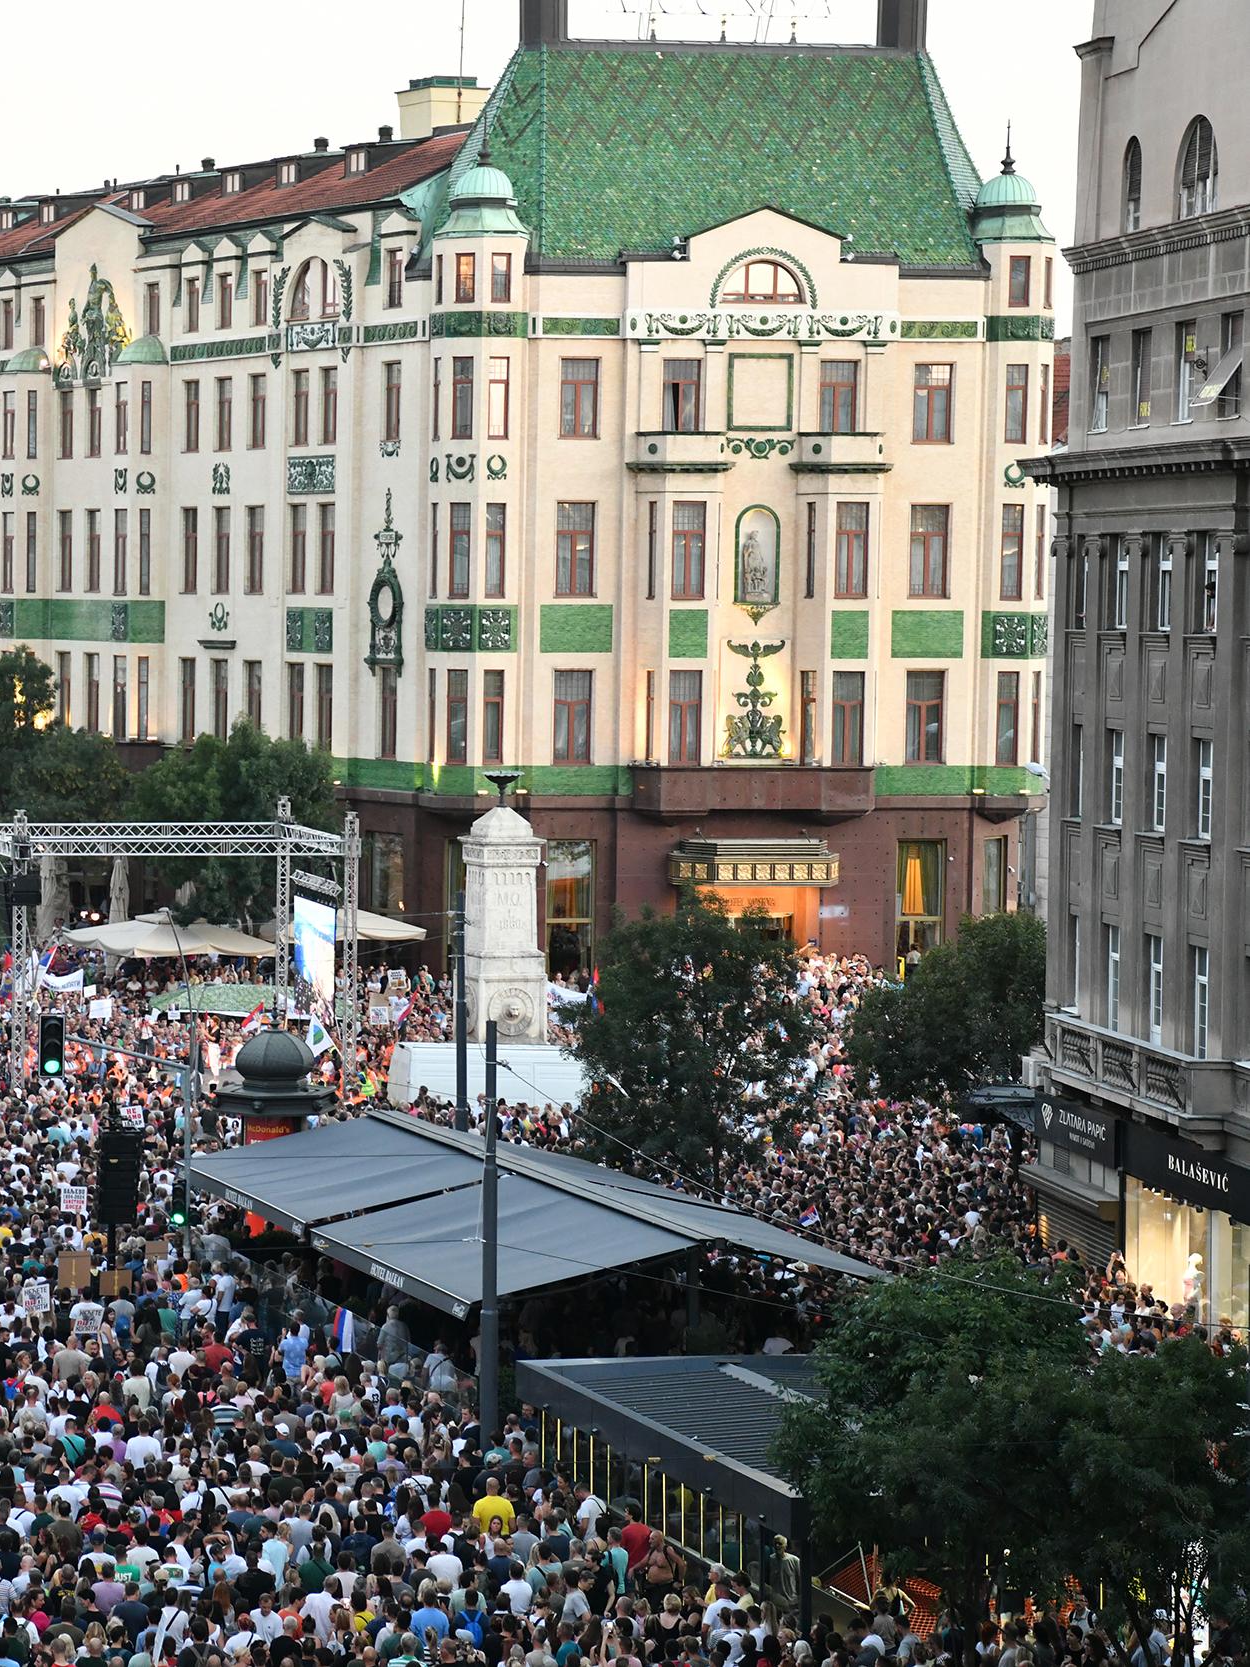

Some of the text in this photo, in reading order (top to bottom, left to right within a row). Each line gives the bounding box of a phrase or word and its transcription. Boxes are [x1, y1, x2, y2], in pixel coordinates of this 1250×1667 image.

[381, 533, 395, 541] 1906
[723, 897, 744, 906] OTEL
[247, 1124, 290, 1134] McDonald's
[1059, 1109, 1106, 1141] ZLATARA PAPIĆ
[1168, 1154, 1229, 1193] BALAŠEVIĆ
[225, 1188, 254, 1210] HOTEL BALKAN
[370, 1263, 405, 1288] HOTEL BALKAN
[114, 1572, 133, 1582] JUST
